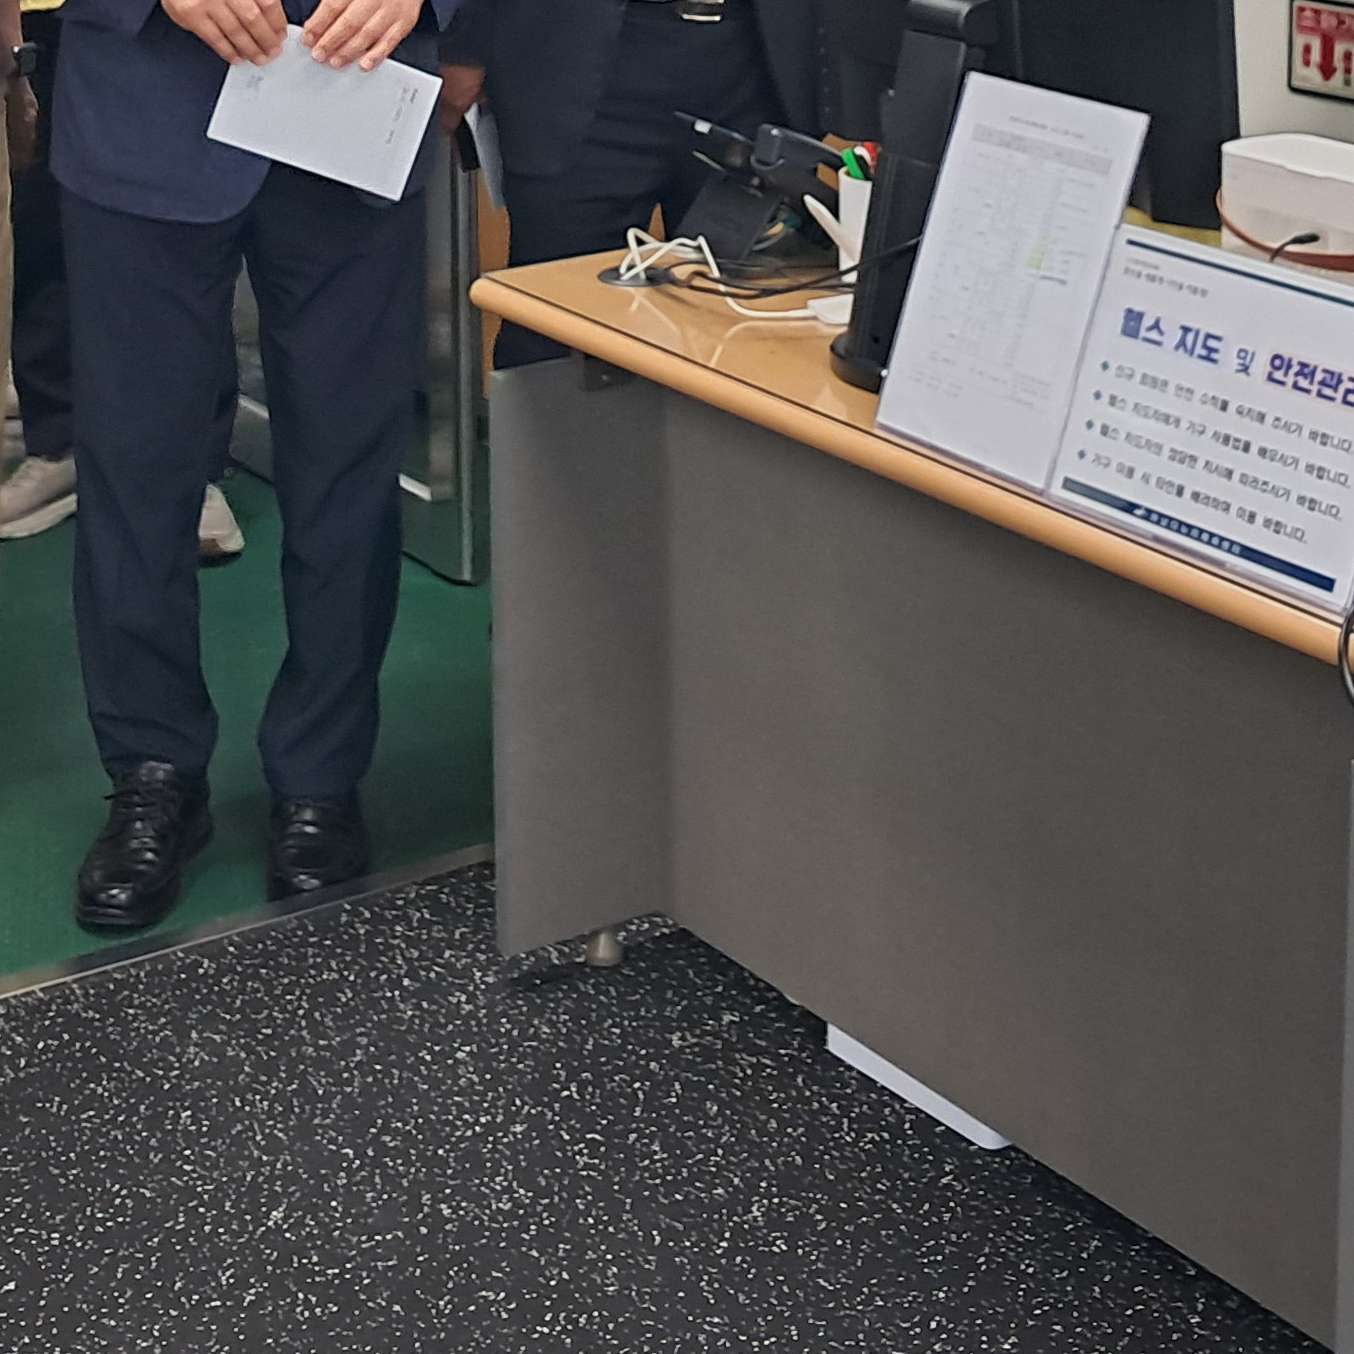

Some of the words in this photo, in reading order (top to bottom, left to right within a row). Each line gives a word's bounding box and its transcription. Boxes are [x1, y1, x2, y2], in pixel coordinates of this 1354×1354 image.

[1173, 323, 1224, 364] 지도
[1231, 346, 1256, 377] 및
[1185, 420, 1207, 437] 기구
[1270, 415, 1303, 437] 주시기
